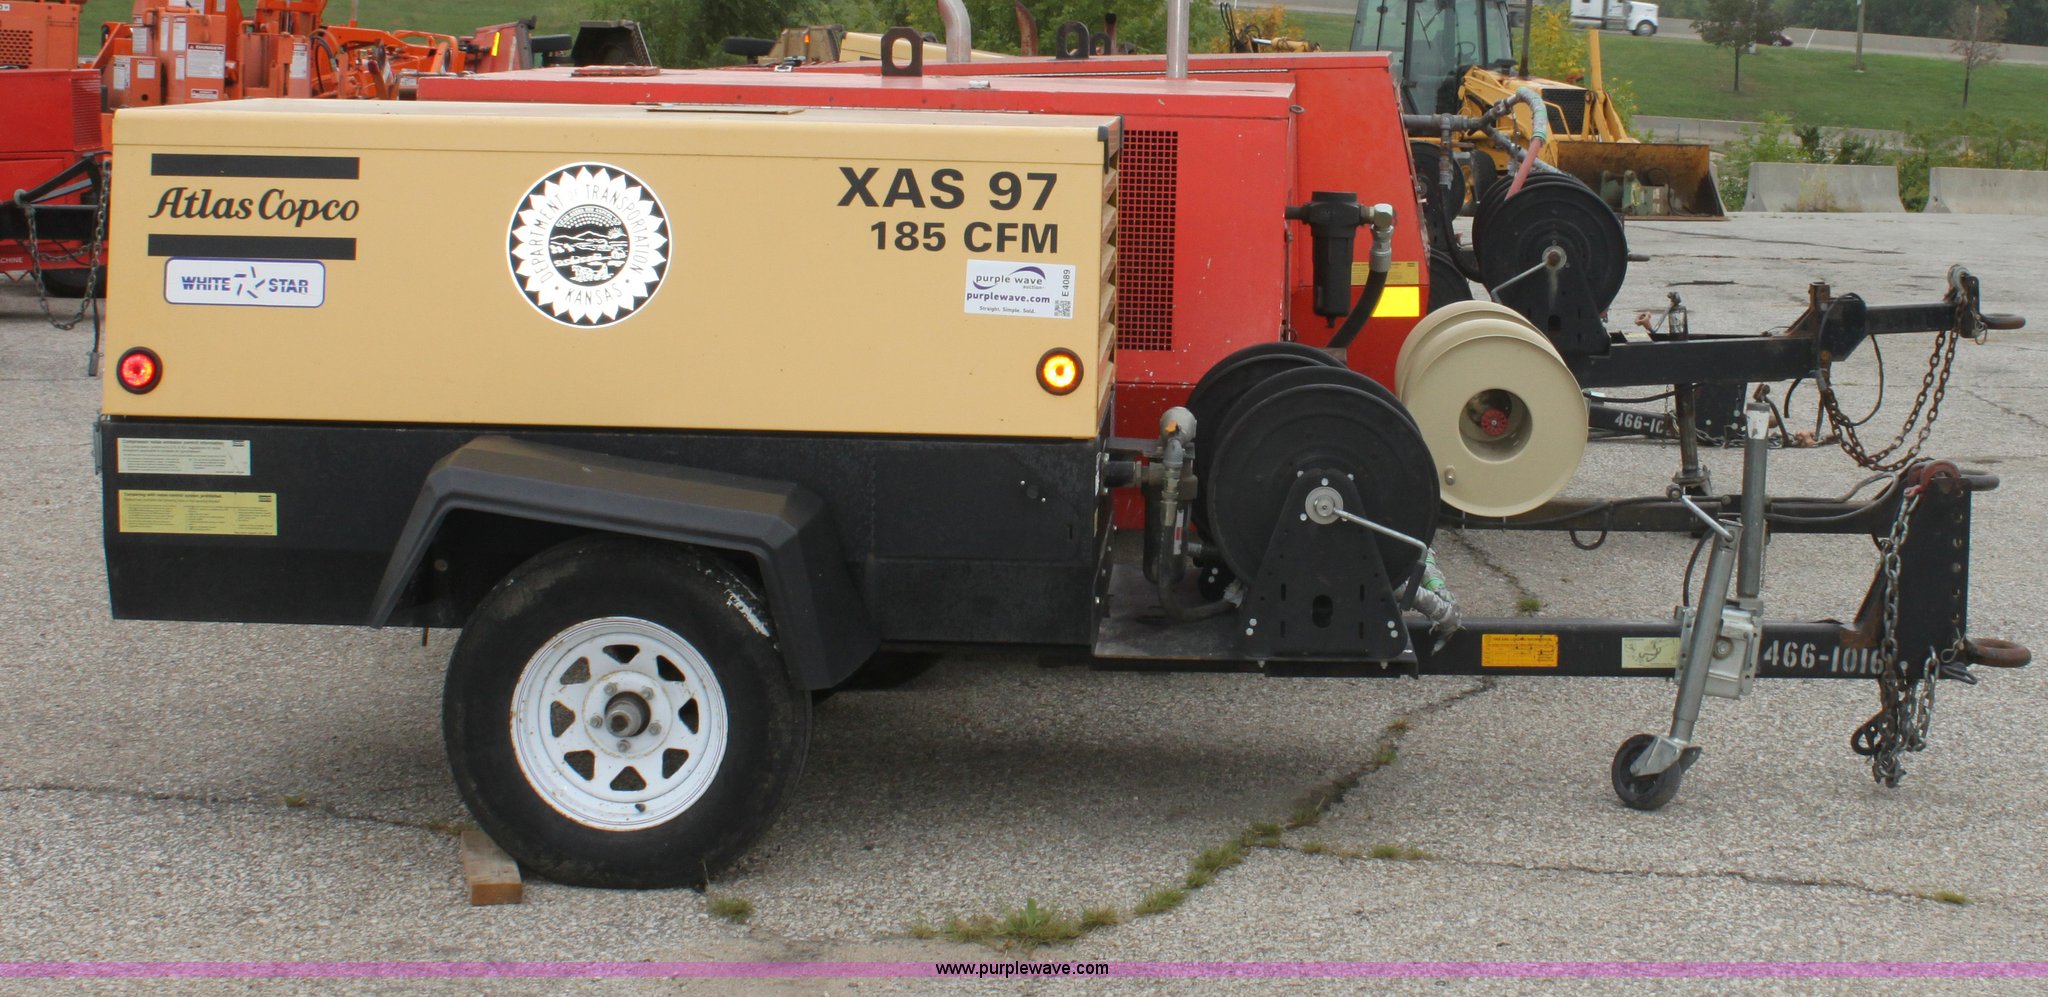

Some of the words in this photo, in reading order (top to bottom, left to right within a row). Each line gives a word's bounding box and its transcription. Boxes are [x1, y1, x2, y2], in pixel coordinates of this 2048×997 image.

[836, 166, 965, 210] XAS
[988, 170, 1058, 211] 97
[148, 186, 254, 220] Atlas
[257, 187, 360, 228] Copco
[529, 194, 563, 284] DEPARTMENT
[585, 183, 650, 275] TRANSPORTATION
[870, 220, 947, 251] 185
[963, 220, 1058, 254] CFM
[181, 276, 231, 291] WHITE
[268, 278, 309, 294] STAR
[565, 282, 623, 306] KANSAS
[966, 291, 1051, 303] purplewave.com
[976, 275, 1011, 284] purple
[1014, 277, 1042, 285] wave
[1763, 639, 1885, 675] 466-1016
